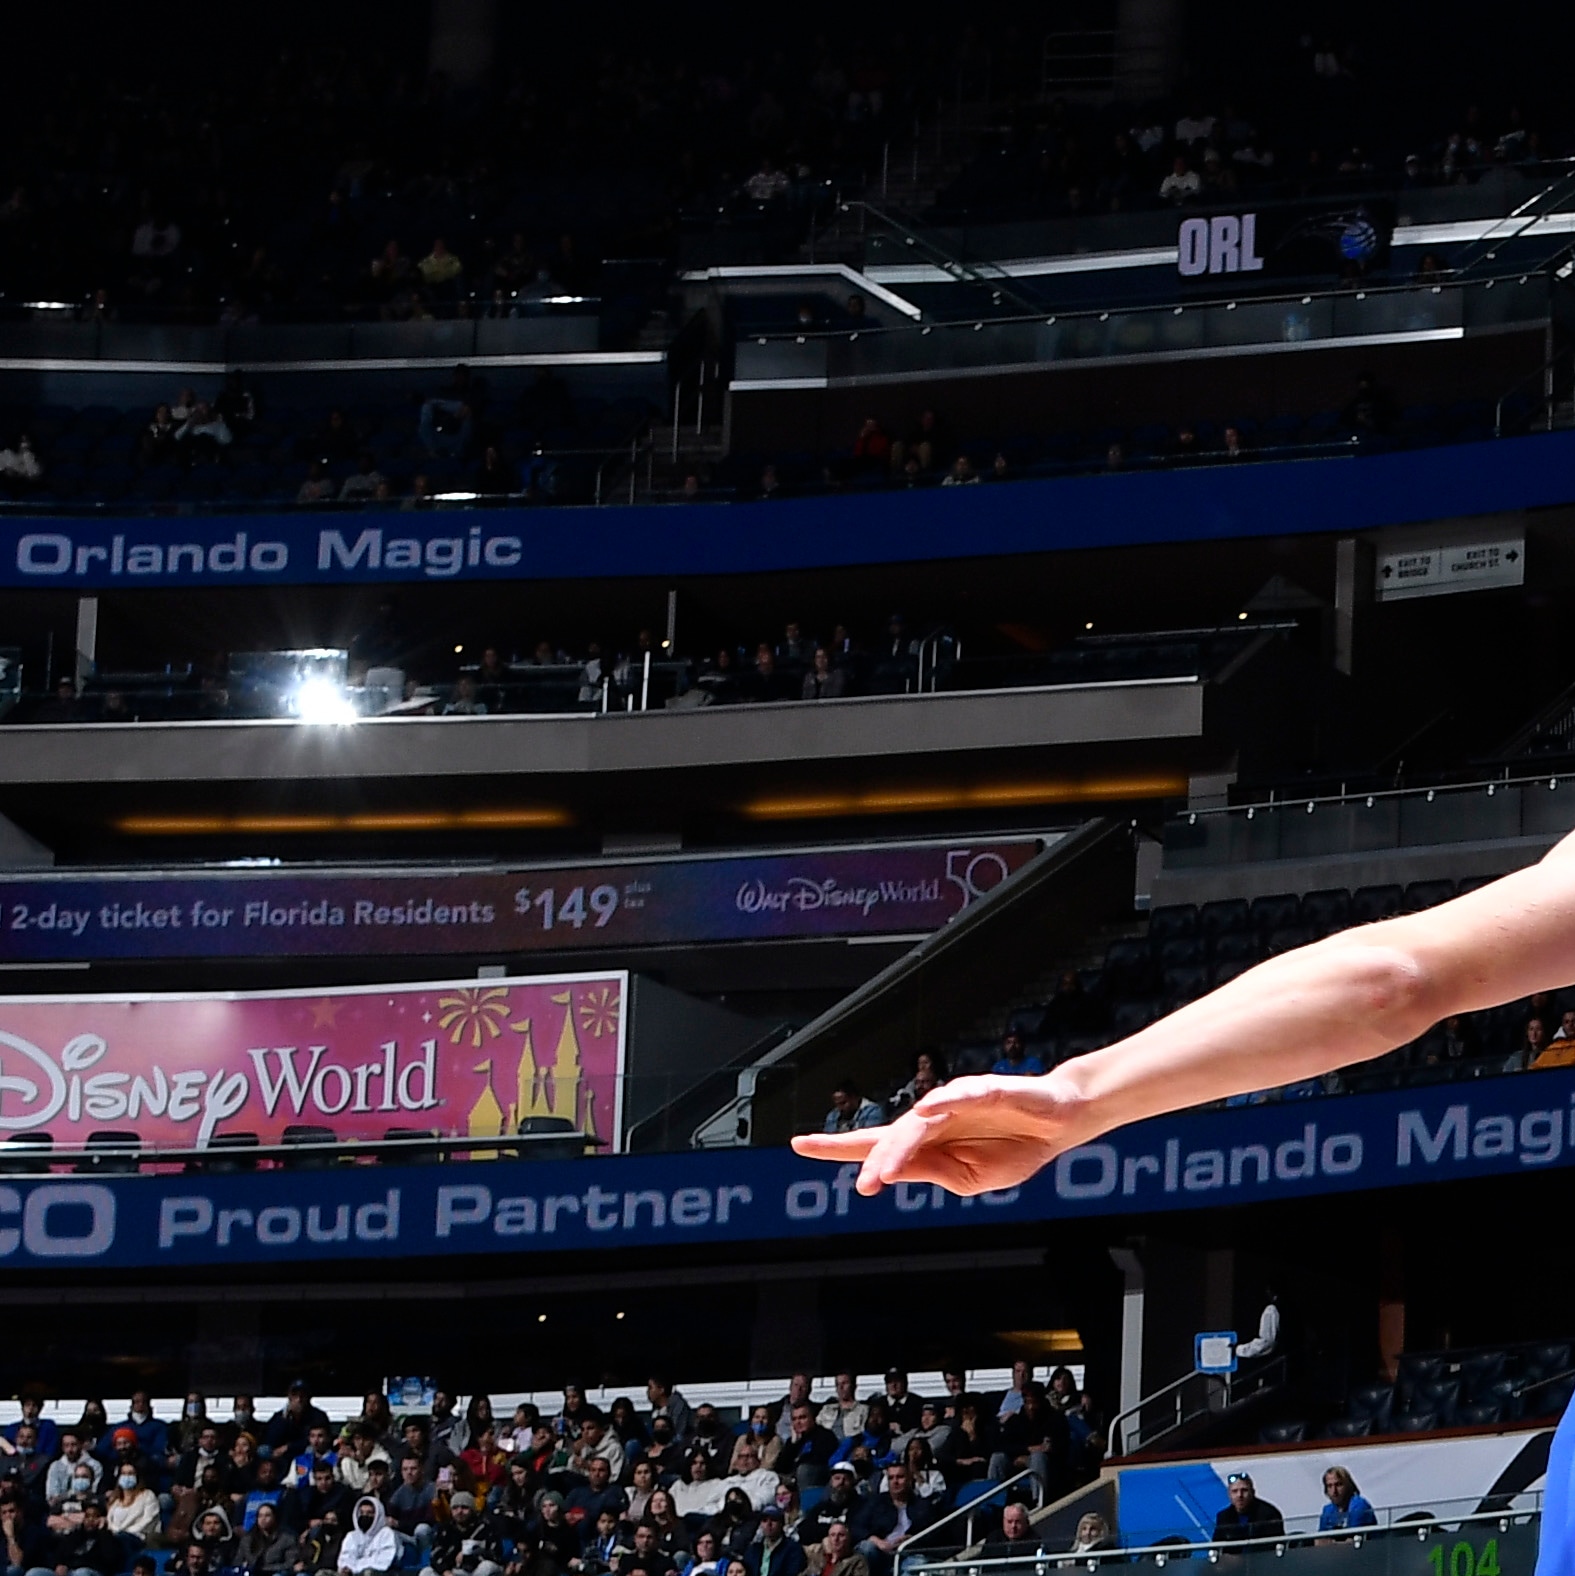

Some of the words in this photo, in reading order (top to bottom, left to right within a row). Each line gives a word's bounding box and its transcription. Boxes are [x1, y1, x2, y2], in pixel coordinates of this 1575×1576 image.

[1177, 213, 1265, 276] ORL
[16, 532, 289, 576] Orlando
[317, 526, 523, 577] Magic
[10, 903, 91, 936] 2-day
[100, 902, 183, 929] ticket
[191, 900, 235, 928] for
[243, 899, 346, 926] Florida
[353, 899, 496, 926] Residents
[513, 883, 620, 931] $149
[247, 1038, 440, 1117] World
[1053, 1122, 1365, 1199] Orlando
[157, 1188, 401, 1249] Proud
[434, 1183, 754, 1239] Partner
[784, 1162, 861, 1220] of
